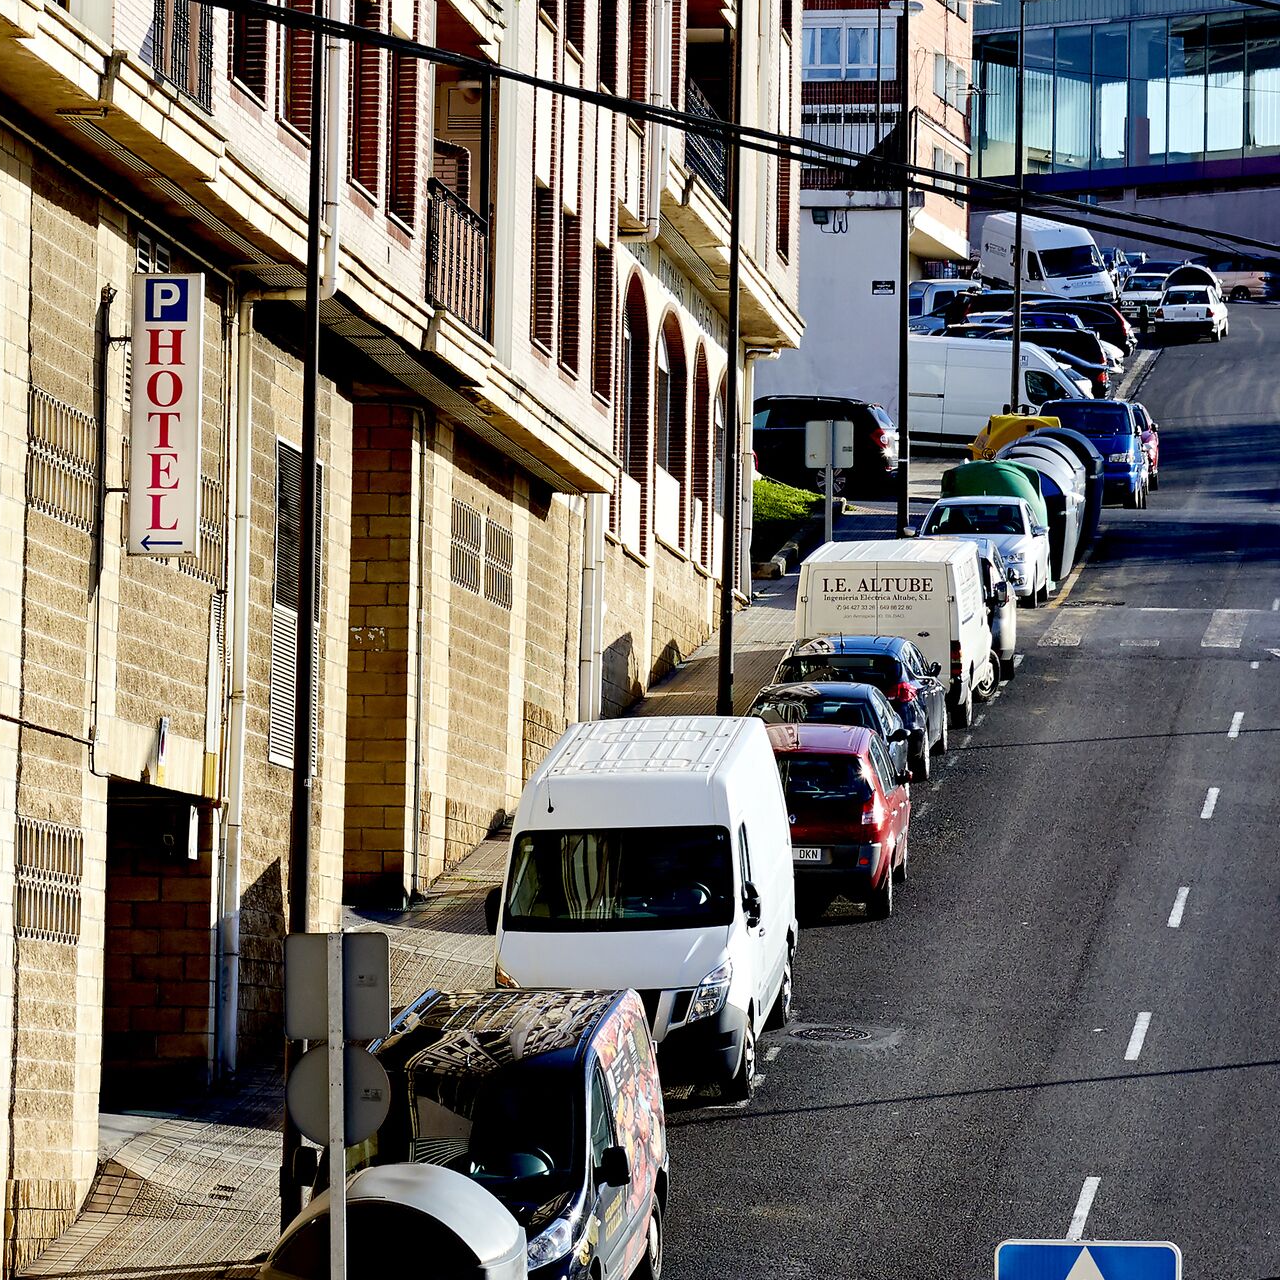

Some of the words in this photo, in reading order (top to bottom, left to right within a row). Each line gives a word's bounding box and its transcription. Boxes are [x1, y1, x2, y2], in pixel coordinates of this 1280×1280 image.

[153, 282, 181, 318] P
[145, 329, 186, 531] HOTEL
[822, 578, 851, 593] I.E.
[857, 578, 933, 593] ALTUBE
[800, 849, 818, 859] DKN
